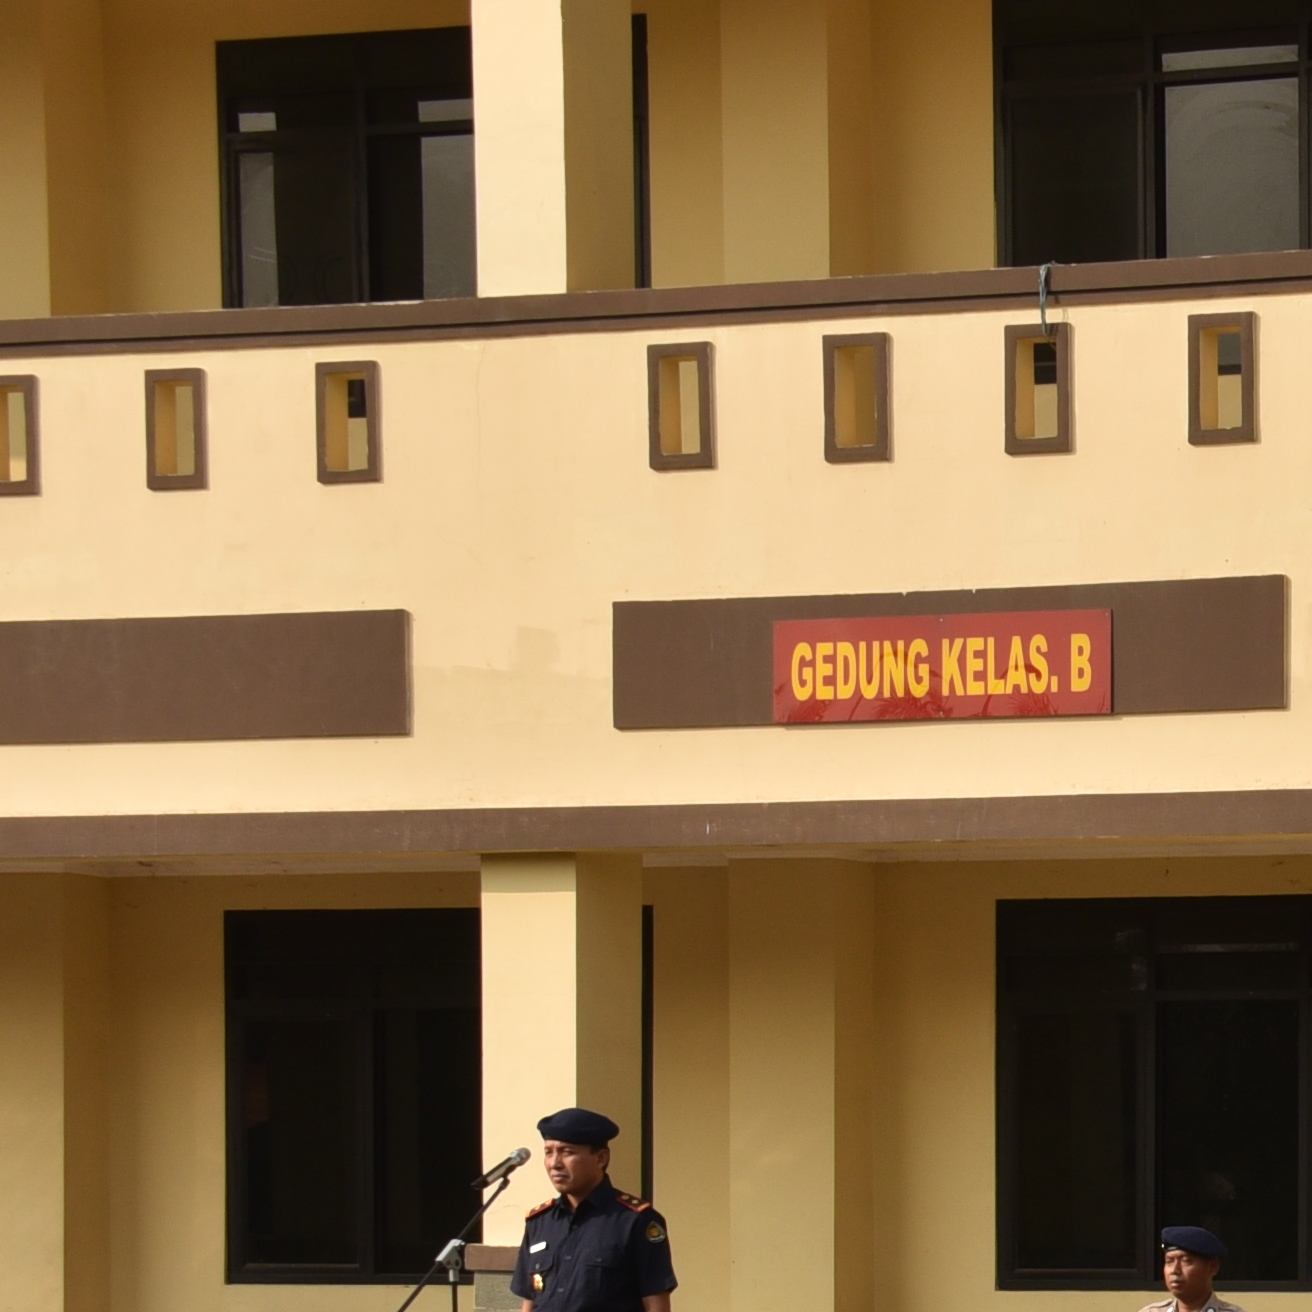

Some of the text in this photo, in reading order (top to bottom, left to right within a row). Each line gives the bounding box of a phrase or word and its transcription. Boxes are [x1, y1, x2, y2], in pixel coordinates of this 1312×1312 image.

[791, 633, 1093, 701] GEDUNG KELAS. B
